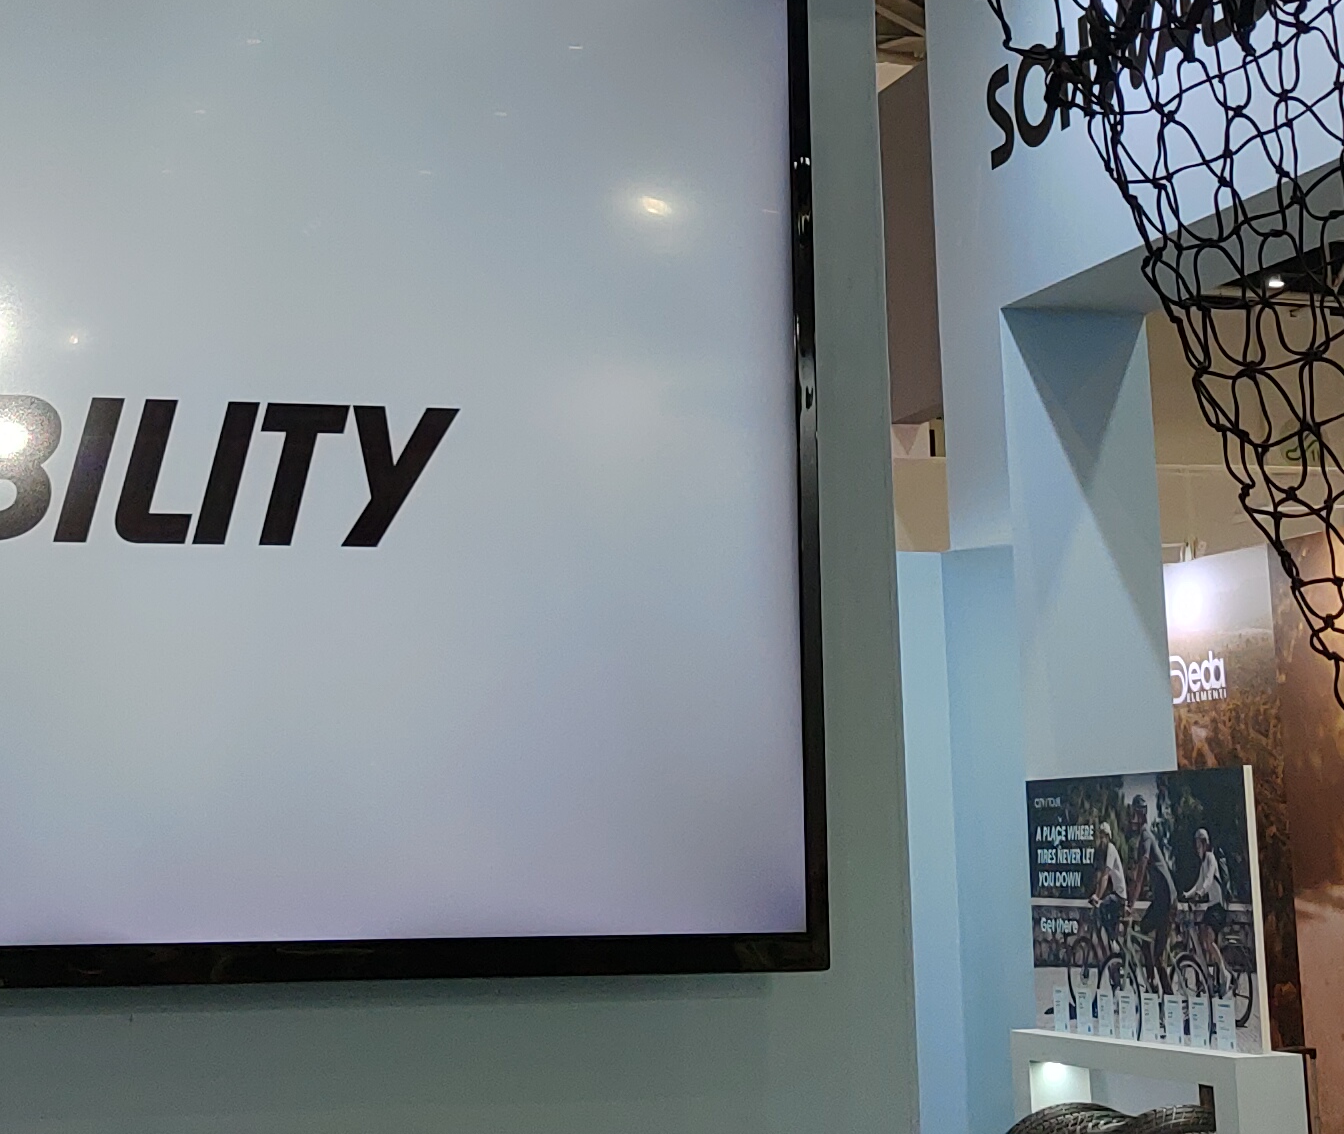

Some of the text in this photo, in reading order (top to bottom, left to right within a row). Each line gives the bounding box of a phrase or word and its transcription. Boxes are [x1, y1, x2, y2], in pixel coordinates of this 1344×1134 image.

[1036, 824, 1094, 842] A PLACE WHERE
[1037, 847, 1094, 865] TIRES NEVER LET
[1038, 871, 1081, 887] YOU DOWN
[1040, 917, 1056, 934] Get
